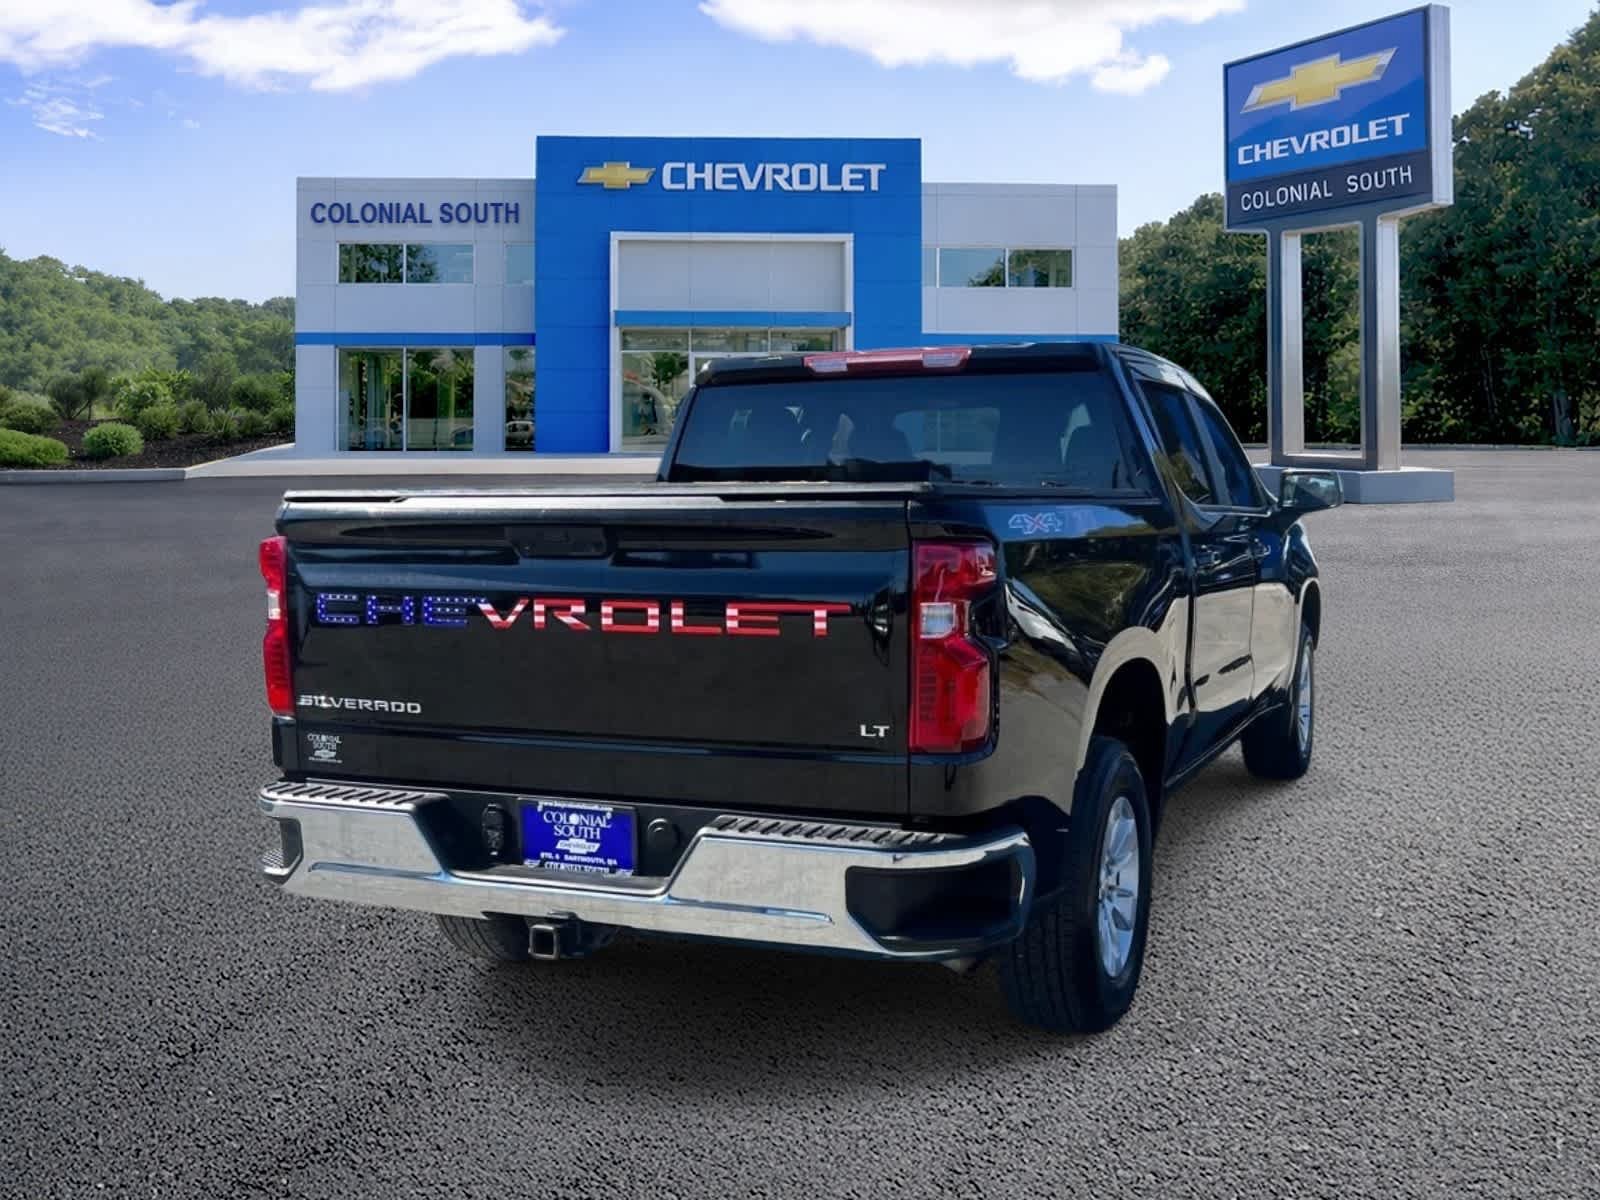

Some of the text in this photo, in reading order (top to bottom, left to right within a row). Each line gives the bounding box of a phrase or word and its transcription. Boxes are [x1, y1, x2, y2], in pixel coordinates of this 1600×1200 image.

[1237, 113, 1410, 165] CHEVROLET
[661, 162, 886, 192] CHEVROLET
[1240, 165, 1412, 211] COLONIAL SOUTH
[310, 202, 521, 224] COLONIAL SOUTH
[316, 592, 852, 637] CHEVROLET
[298, 694, 422, 714] SILVERADO
[859, 724, 890, 738] LT
[553, 824, 601, 840] SOUTH
